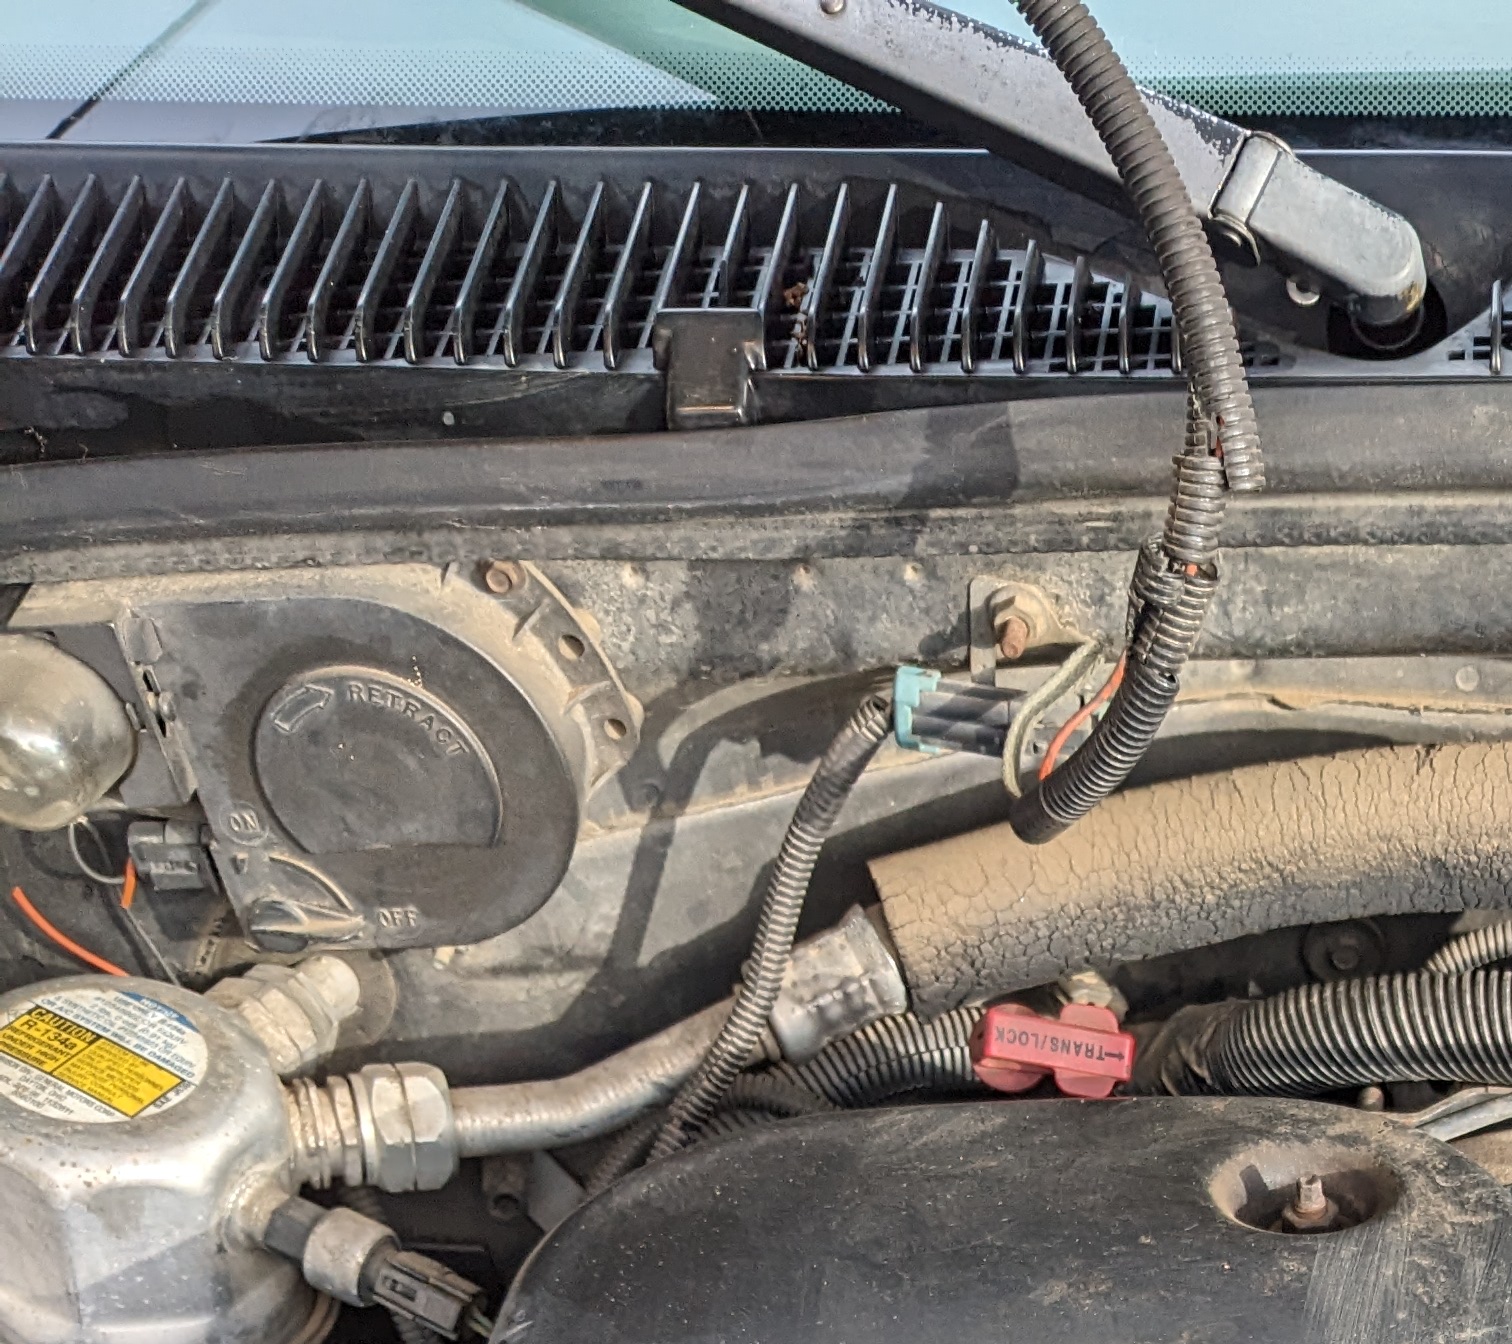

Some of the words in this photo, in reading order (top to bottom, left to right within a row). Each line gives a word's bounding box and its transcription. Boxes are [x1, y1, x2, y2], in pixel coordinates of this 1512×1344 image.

[347, 680, 470, 756] RETRACT
[229, 807, 260, 834] ON
[377, 905, 418, 929] OFF
[20, 1018, 79, 1050] R-134a
[30, 1007, 95, 1043] CAUTION
[995, 1025, 1105, 1061] TRANS/LOCK
